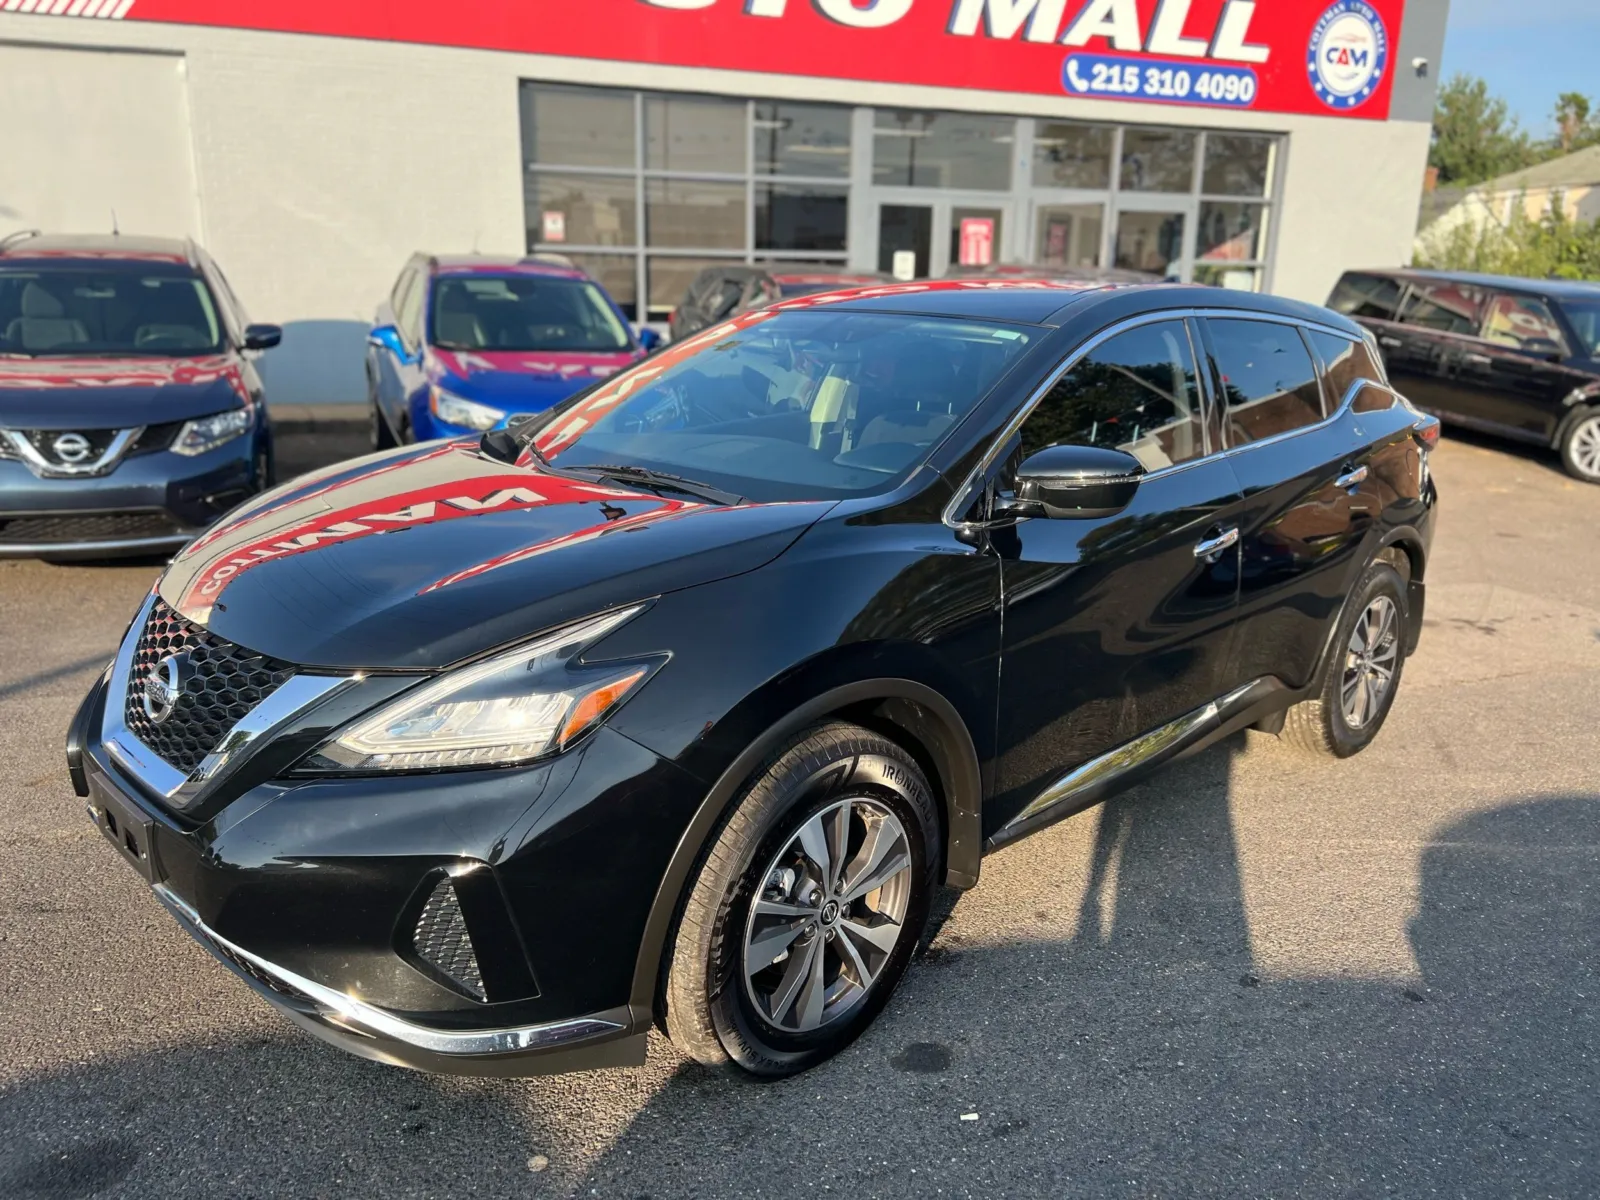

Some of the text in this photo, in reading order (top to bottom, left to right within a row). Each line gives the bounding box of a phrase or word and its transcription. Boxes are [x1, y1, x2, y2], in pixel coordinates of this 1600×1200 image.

[1326, 47, 1369, 68] CAM
[1091, 63, 1255, 102] 215 310 4090
